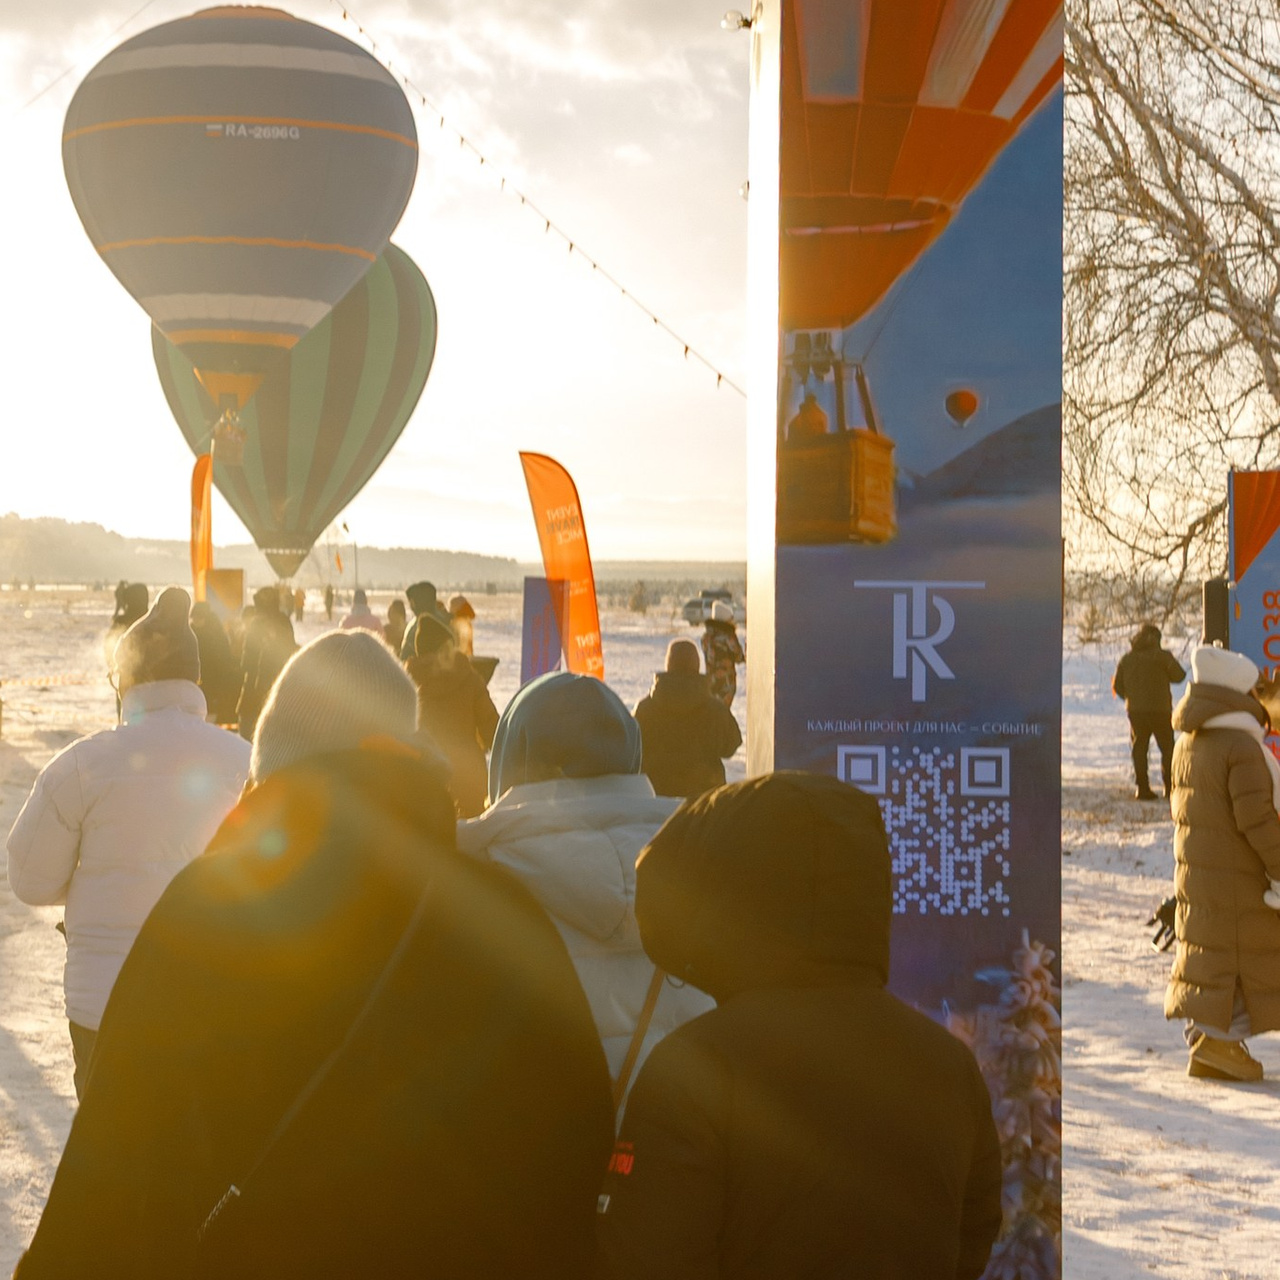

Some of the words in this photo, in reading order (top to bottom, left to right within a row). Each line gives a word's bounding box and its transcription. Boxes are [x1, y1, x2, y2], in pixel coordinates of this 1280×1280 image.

[807, 718, 862, 733] КАЖДЫЙ
[864, 720, 911, 733] ПРОЕКТ
[912, 721, 938, 734] ДЛЯ
[940, 721, 966, 734] НАС
[982, 722, 1042, 736] СОБЫТИЕ
